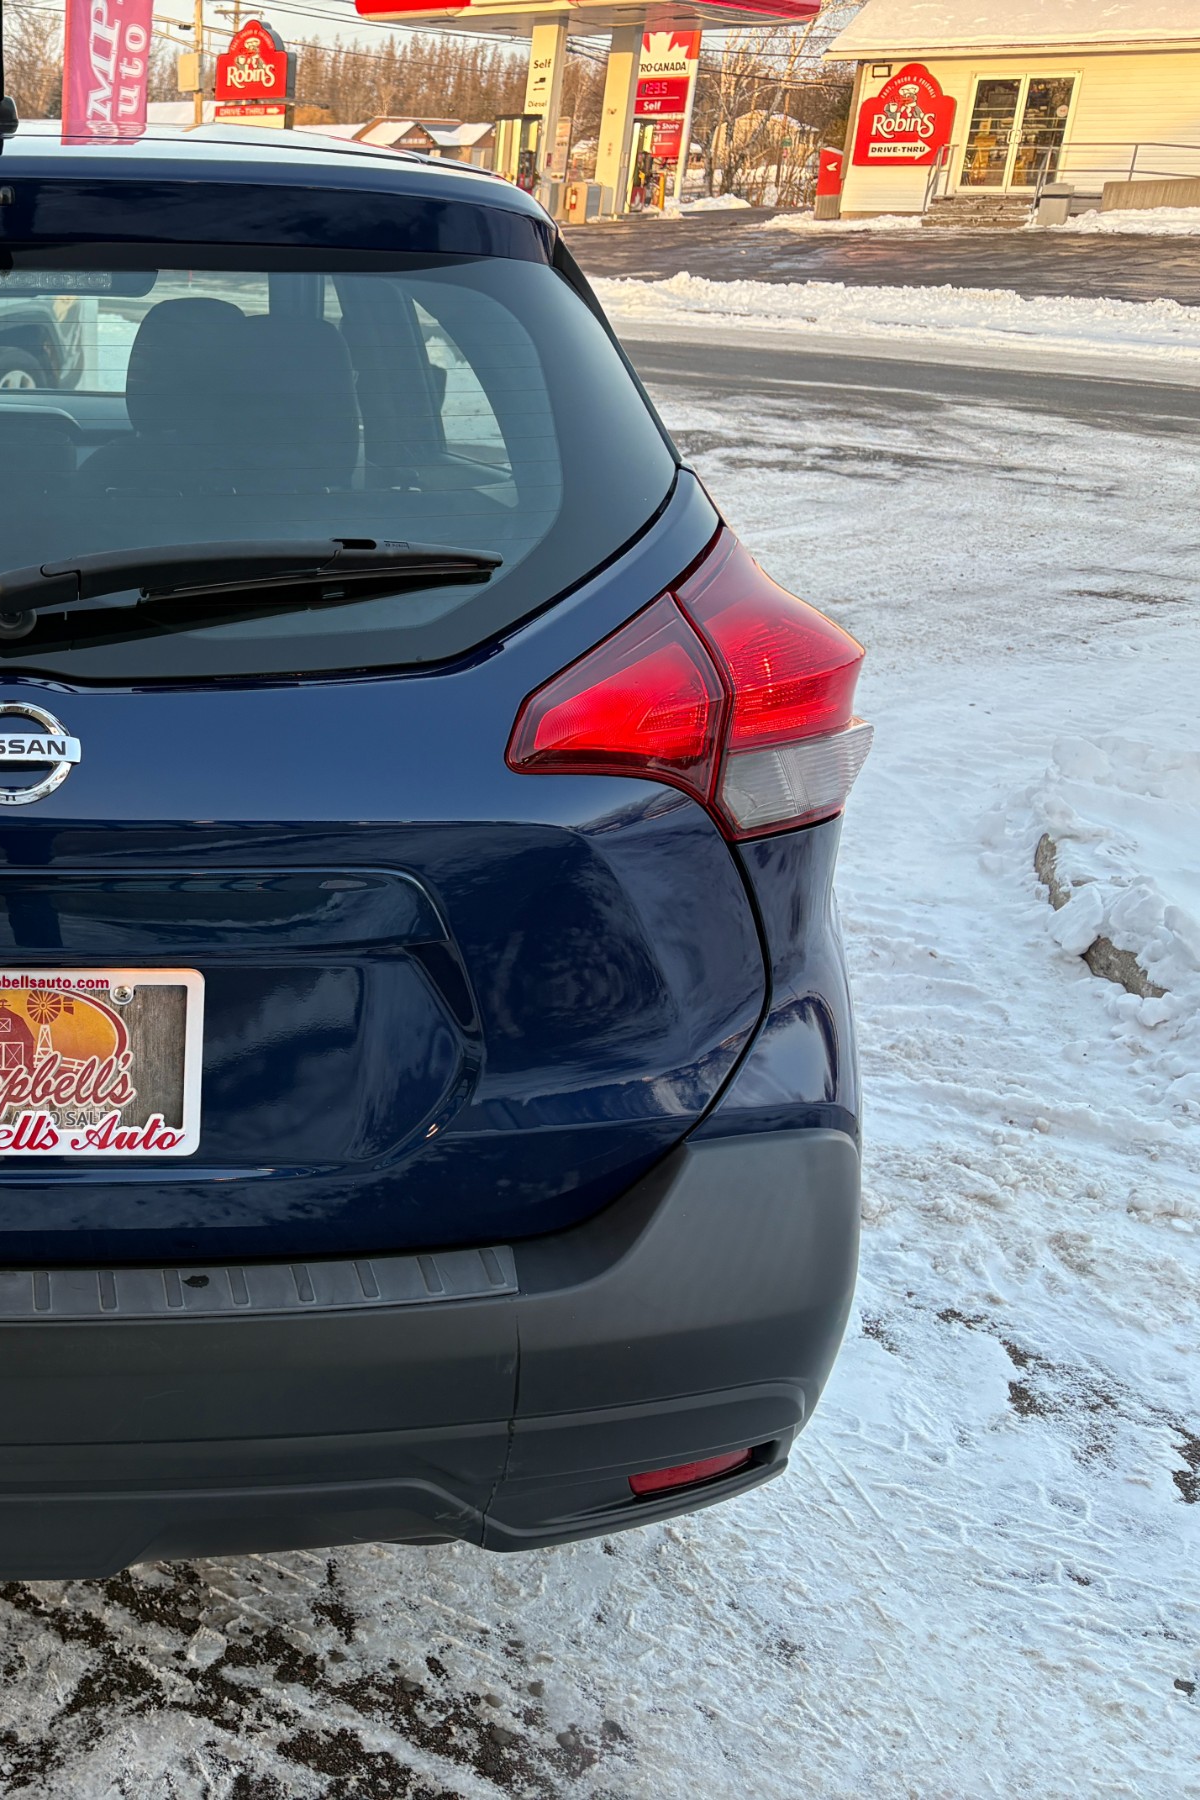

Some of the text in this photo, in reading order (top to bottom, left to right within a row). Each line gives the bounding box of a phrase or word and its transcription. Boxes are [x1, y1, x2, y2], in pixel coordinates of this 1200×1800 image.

[533, 58, 552, 69] Self
[527, 100, 548, 108] Diesel
[643, 101, 661, 111] Self
[220, 106, 266, 116] DRIVE-THRU
[11, 1111, 60, 1126] AO
[70, 1113, 187, 1151] Auto
